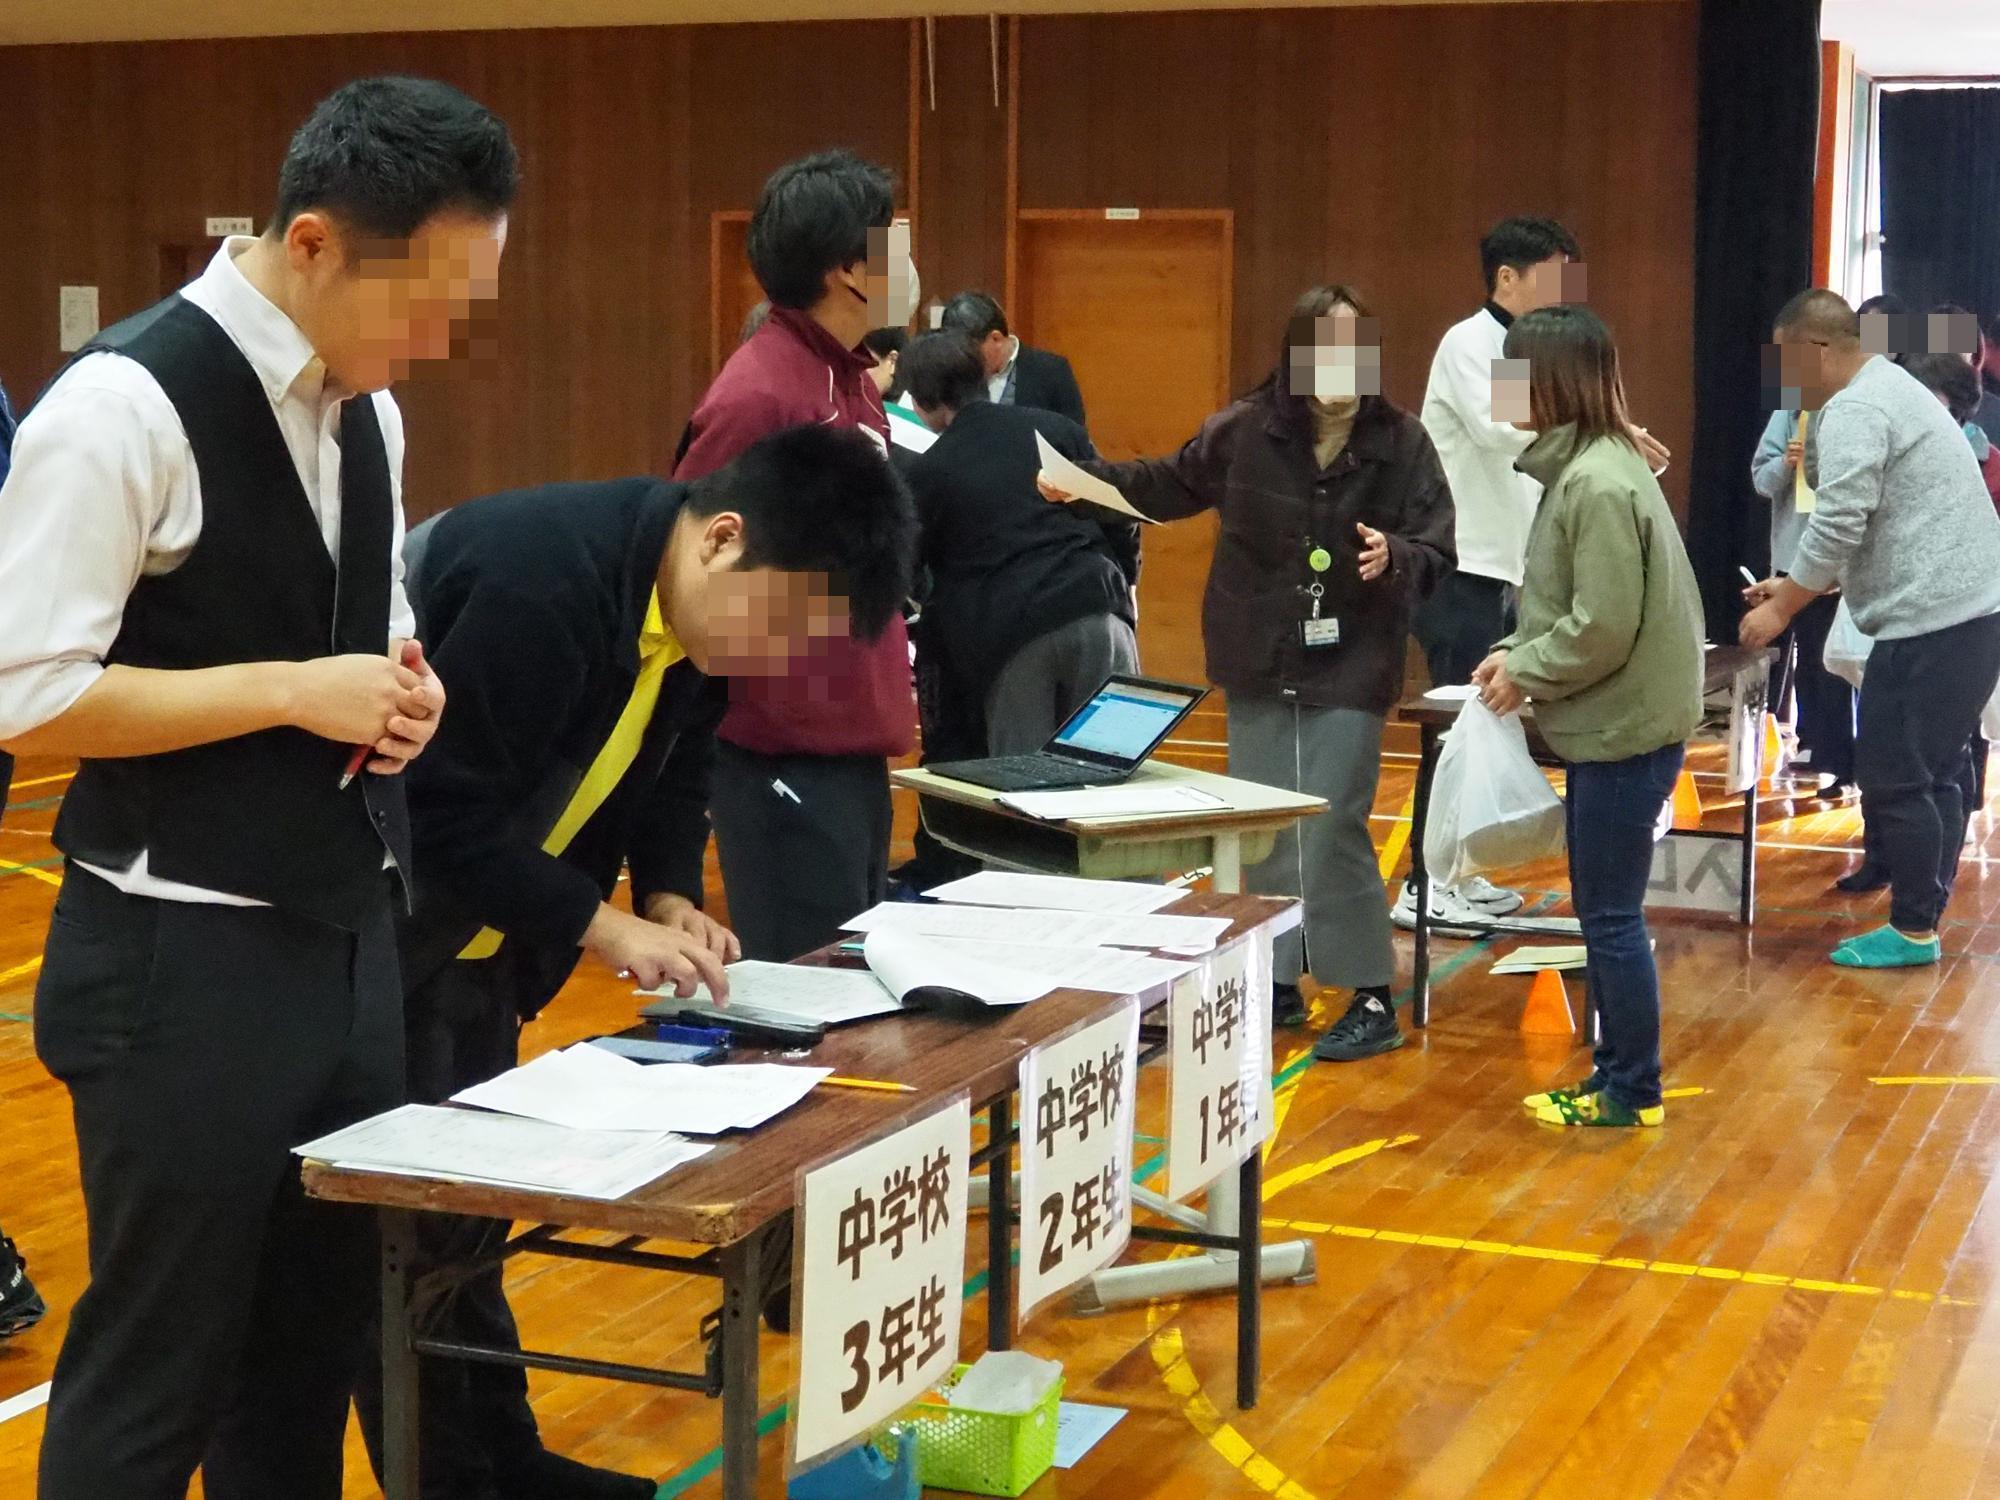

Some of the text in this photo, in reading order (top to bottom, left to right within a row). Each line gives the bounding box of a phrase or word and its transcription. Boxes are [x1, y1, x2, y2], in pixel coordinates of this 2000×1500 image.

[1192, 969, 1248, 1065] 中学
[1036, 1043, 1124, 1159] 中学校
[837, 1145, 951, 1281] 中学校
[1038, 1156, 1124, 1275] 2年生
[840, 1274, 946, 1414] 3年生
